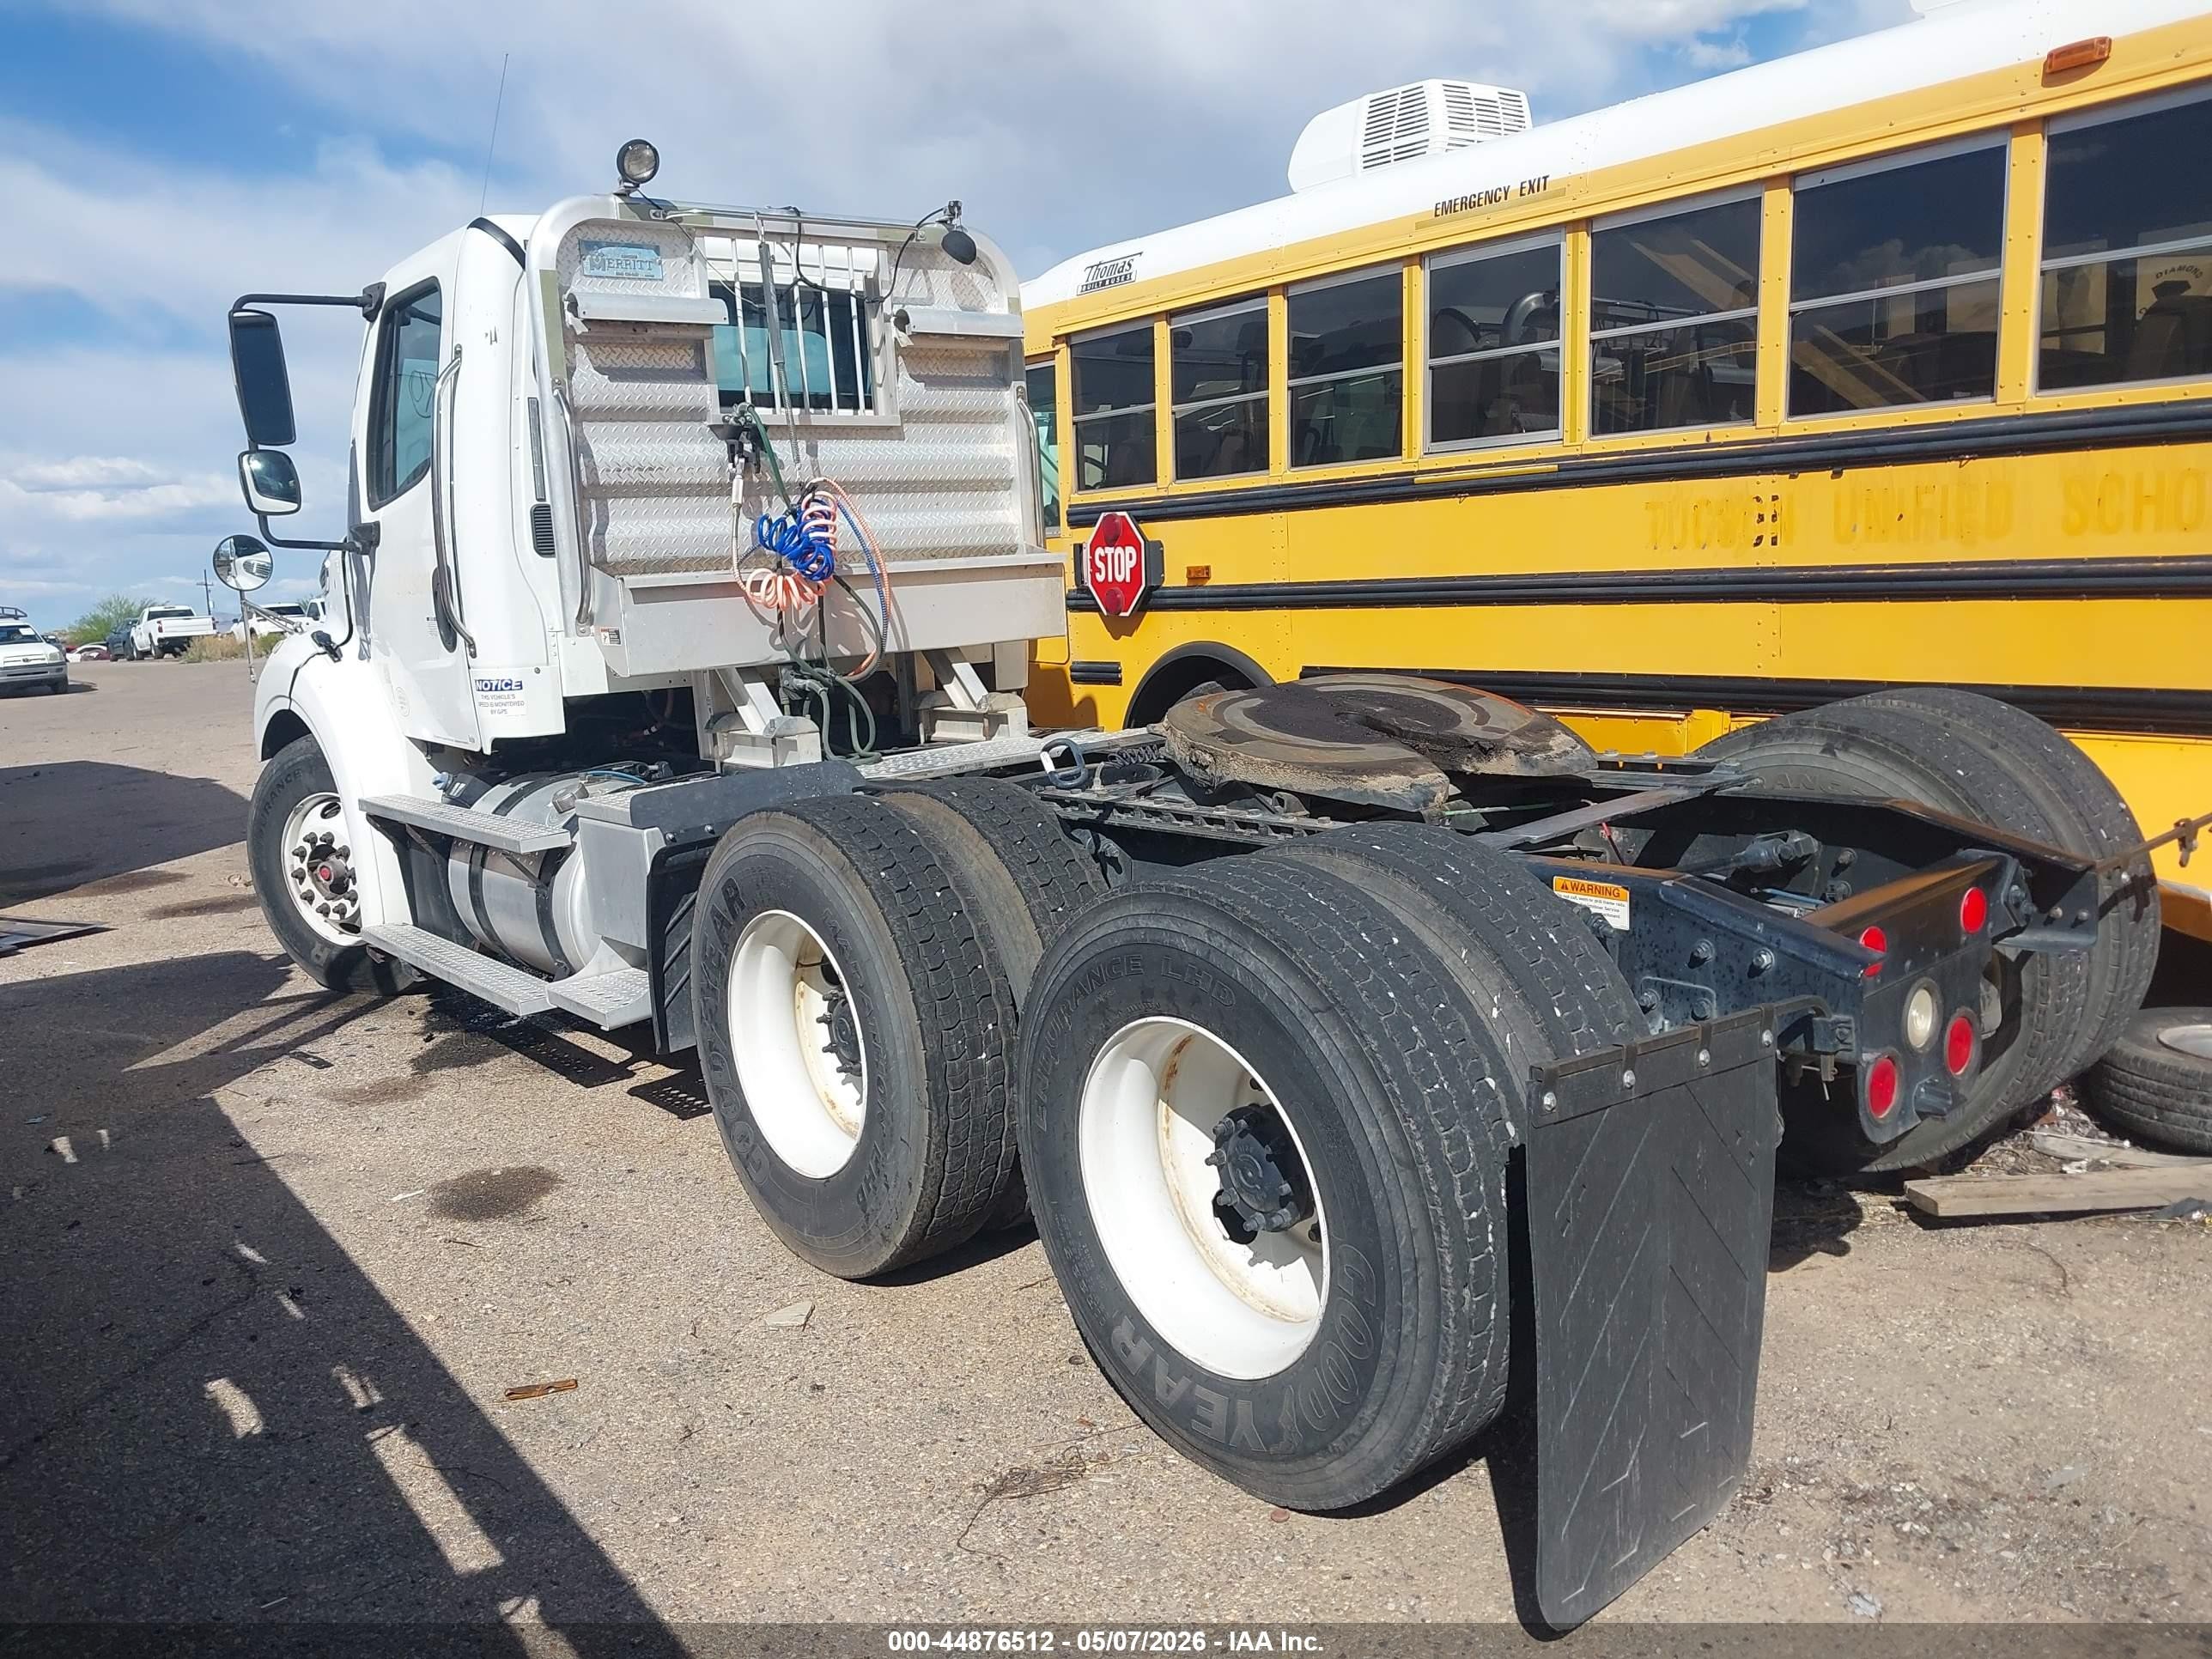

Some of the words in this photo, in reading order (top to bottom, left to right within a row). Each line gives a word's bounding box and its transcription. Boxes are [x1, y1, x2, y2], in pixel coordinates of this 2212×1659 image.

[1434, 185, 1510, 217] EMERGENCY
[1519, 174, 1550, 198] EXIT
[589, 252, 653, 271] MERRITT
[1084, 252, 1143, 283] Thomas
[2155, 264, 2204, 279] DIAMOND
[1081, 280, 1103, 293] BUILT
[1833, 481, 2014, 546] UNIFIED
[1094, 545, 1137, 583] STOP
[475, 679, 522, 691] NOTICE
[1570, 881, 1620, 898] WARNING
[1036, 954, 1144, 1133] ENDURANCE
[1160, 955, 1237, 1009] LHD
